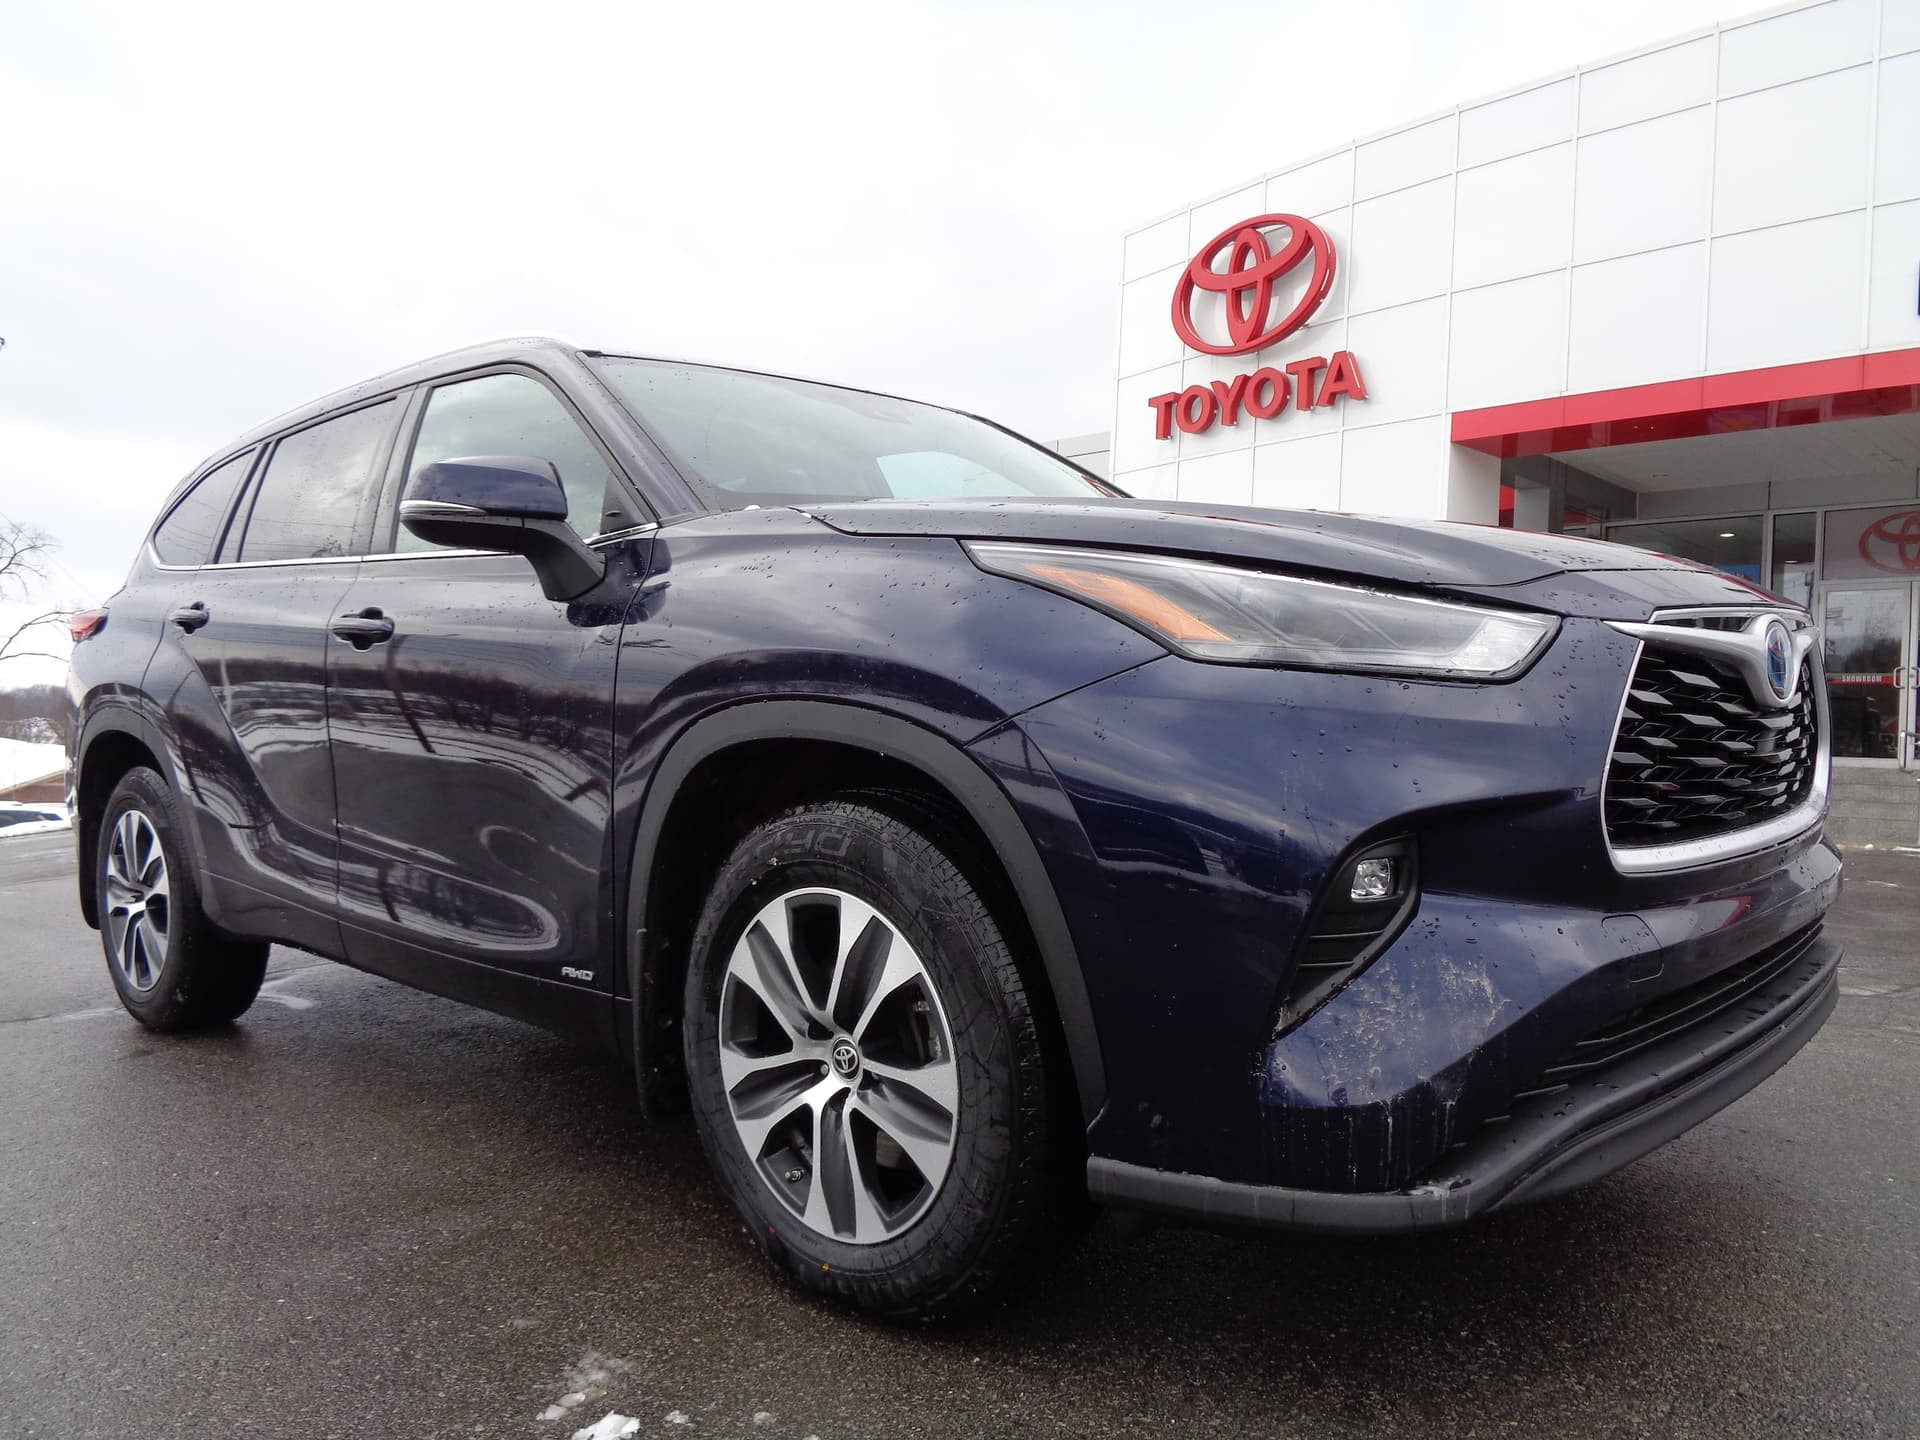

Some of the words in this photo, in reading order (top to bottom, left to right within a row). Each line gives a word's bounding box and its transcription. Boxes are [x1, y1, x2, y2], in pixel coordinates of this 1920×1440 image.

[1148, 350, 1368, 440] TOYOTA
[1841, 675, 1882, 683] SHOWROOM
[561, 966, 593, 981] AWD
